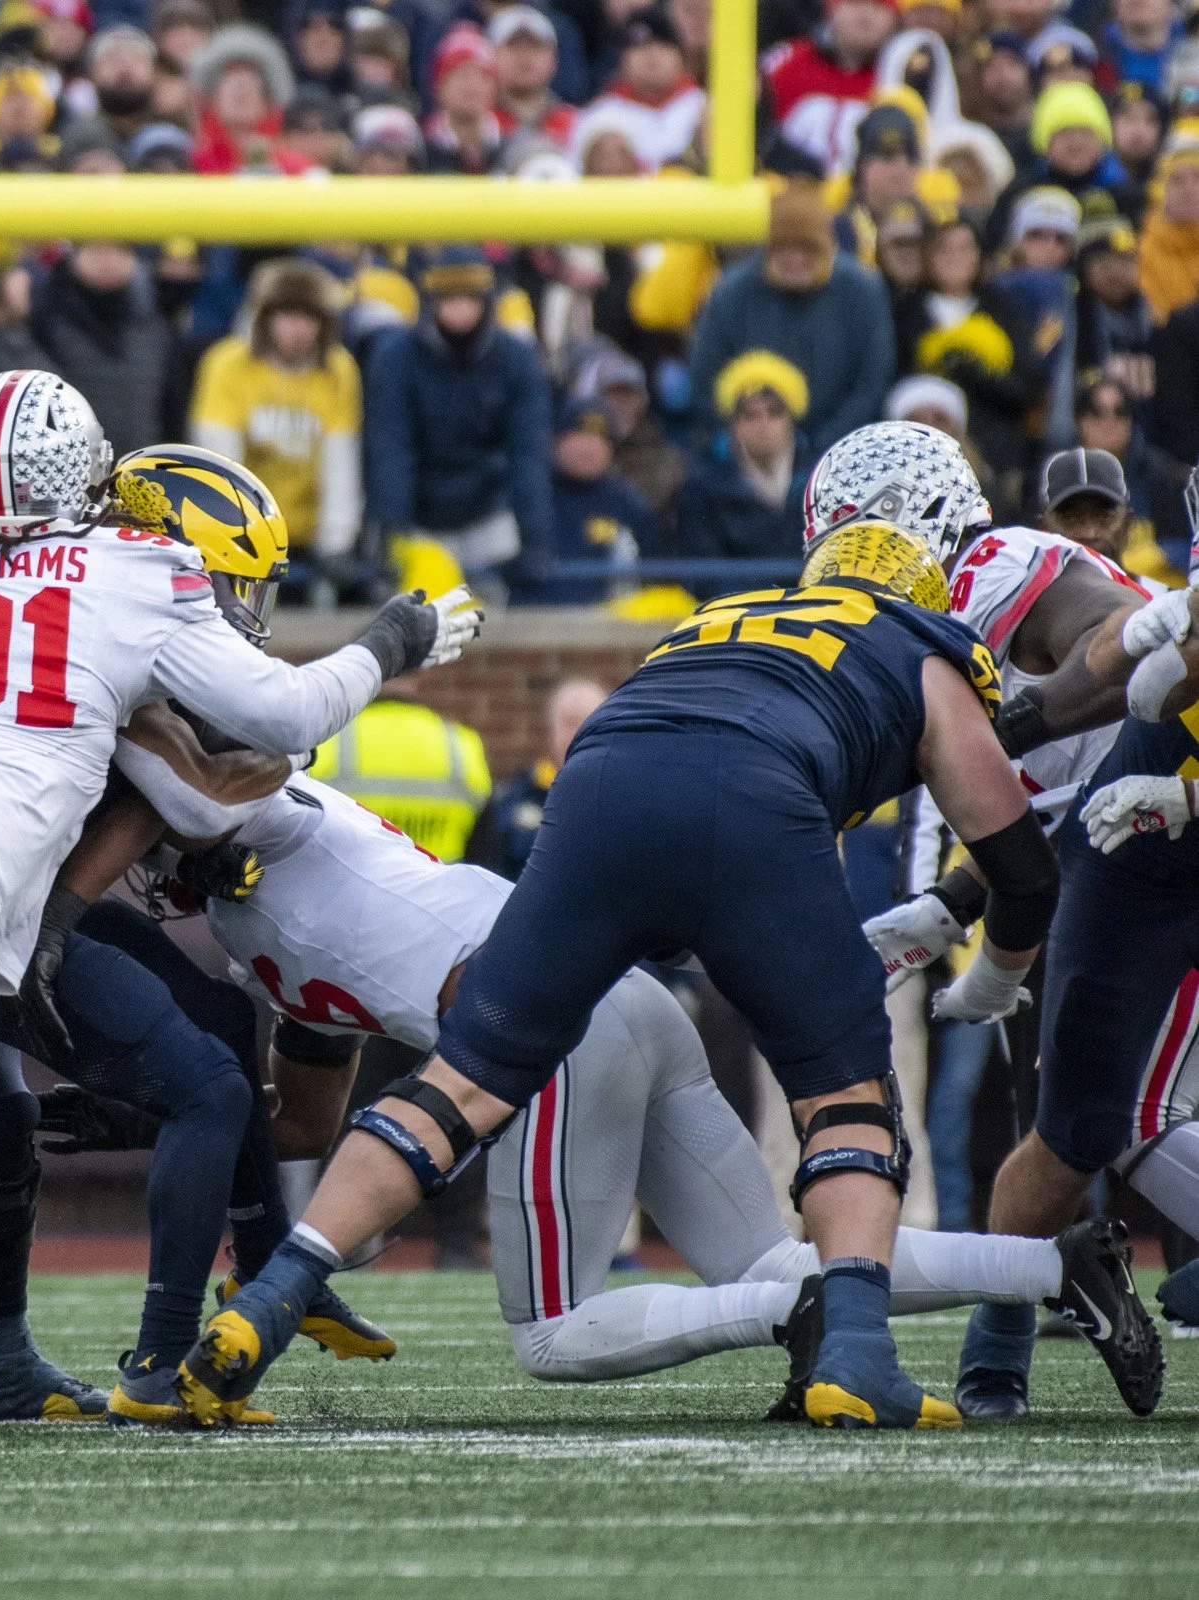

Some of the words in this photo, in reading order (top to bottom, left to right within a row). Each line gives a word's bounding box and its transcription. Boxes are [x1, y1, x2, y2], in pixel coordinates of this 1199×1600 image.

[640, 585, 880, 672] 52
[375, 1118, 418, 1153] DONJOY
[807, 1152, 856, 1168] DONJOY
